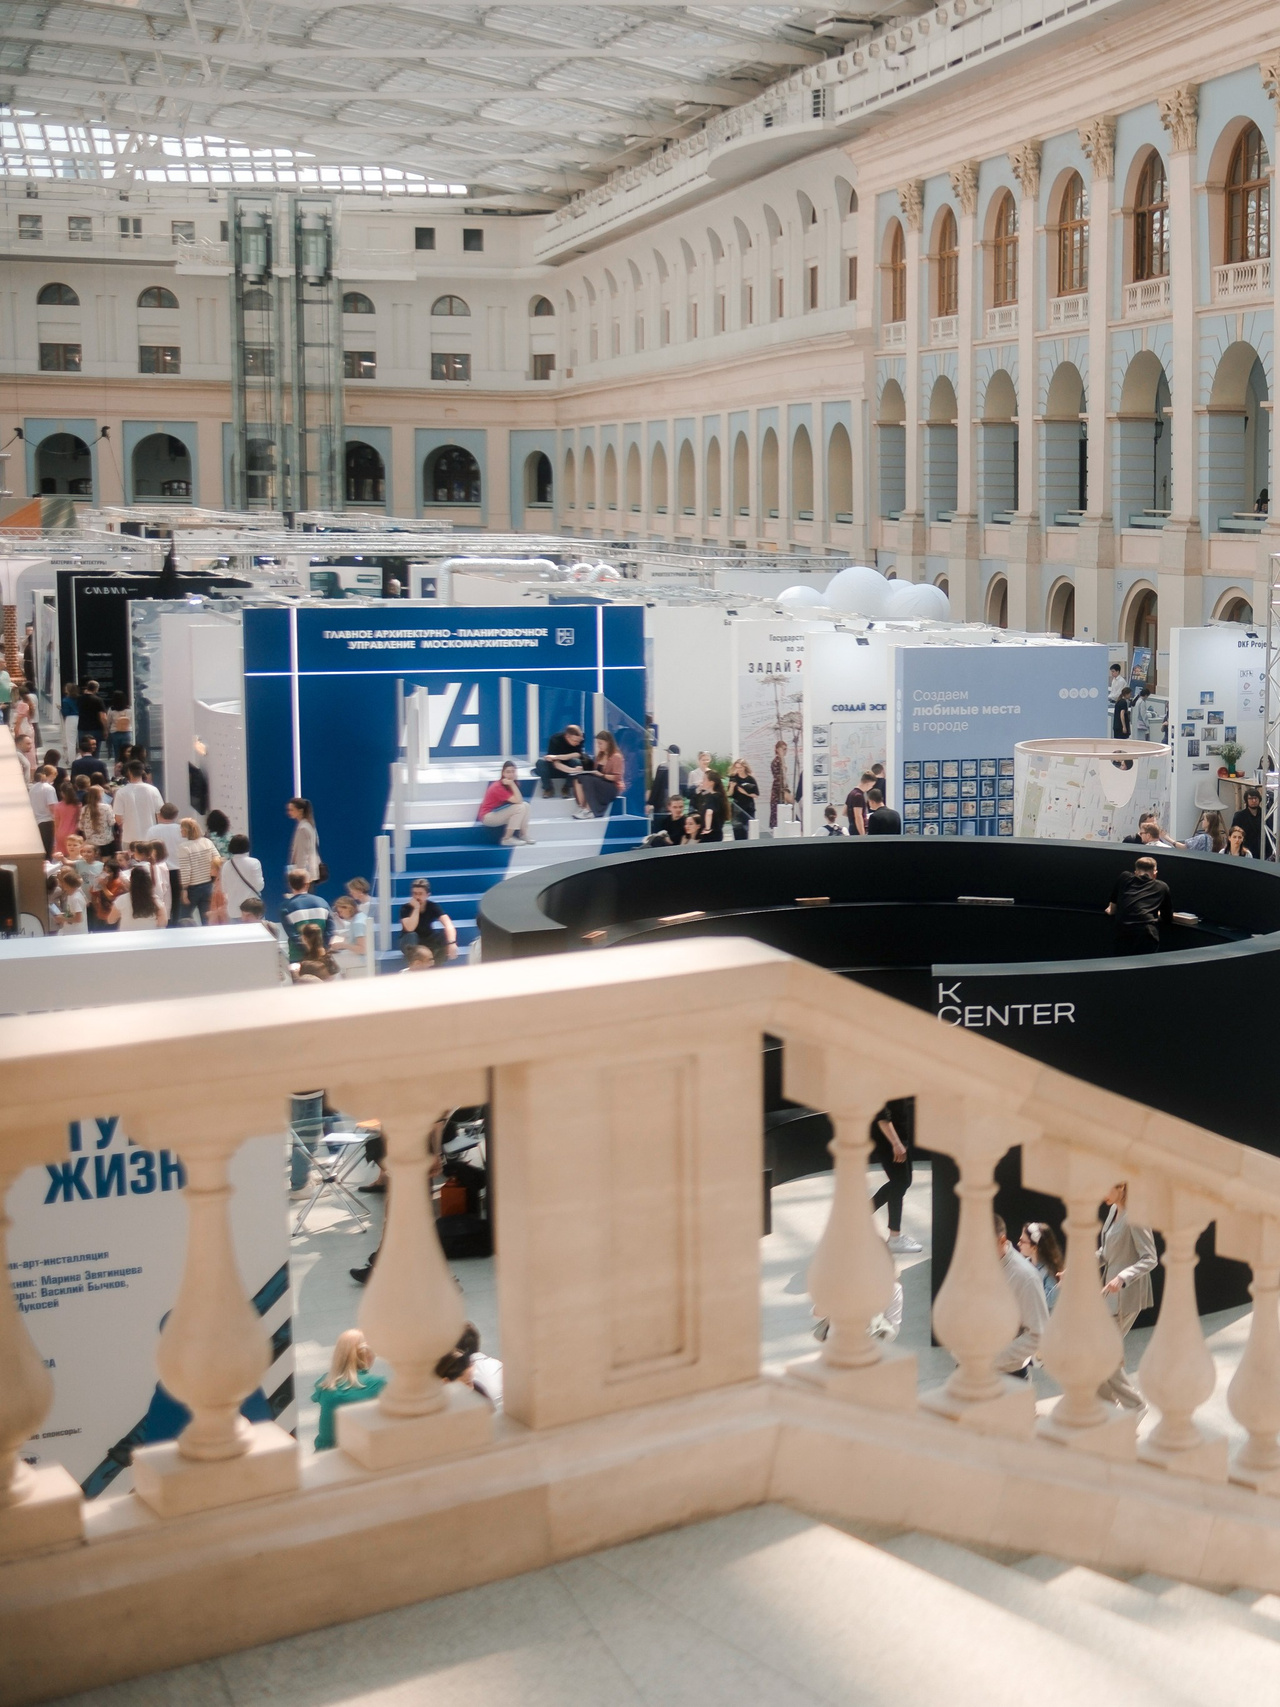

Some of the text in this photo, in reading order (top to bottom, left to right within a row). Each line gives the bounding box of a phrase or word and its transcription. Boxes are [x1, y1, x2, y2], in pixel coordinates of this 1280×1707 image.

[322, 629, 373, 640] ГЛАВНОЕ
[347, 638, 539, 649] УПРАВЛЕНИЕ МОСКОМАРХИТЕКТУРЫ
[913, 689, 969, 702] Создаем
[831, 702, 866, 712] СОЗДАЙ
[913, 703, 1021, 716] любимые места
[913, 721, 969, 734] в городе
[938, 982, 962, 1004] K
[937, 1002, 1076, 1027] CENTER
[43, 1148, 189, 1205] ЖИЗН
[41, 1274, 81, 1286] Марина
[85, 1266, 143, 1281] Звягинцева
[41, 1284, 84, 1298] Василий
[88, 1280, 129, 1292] Бычков,
